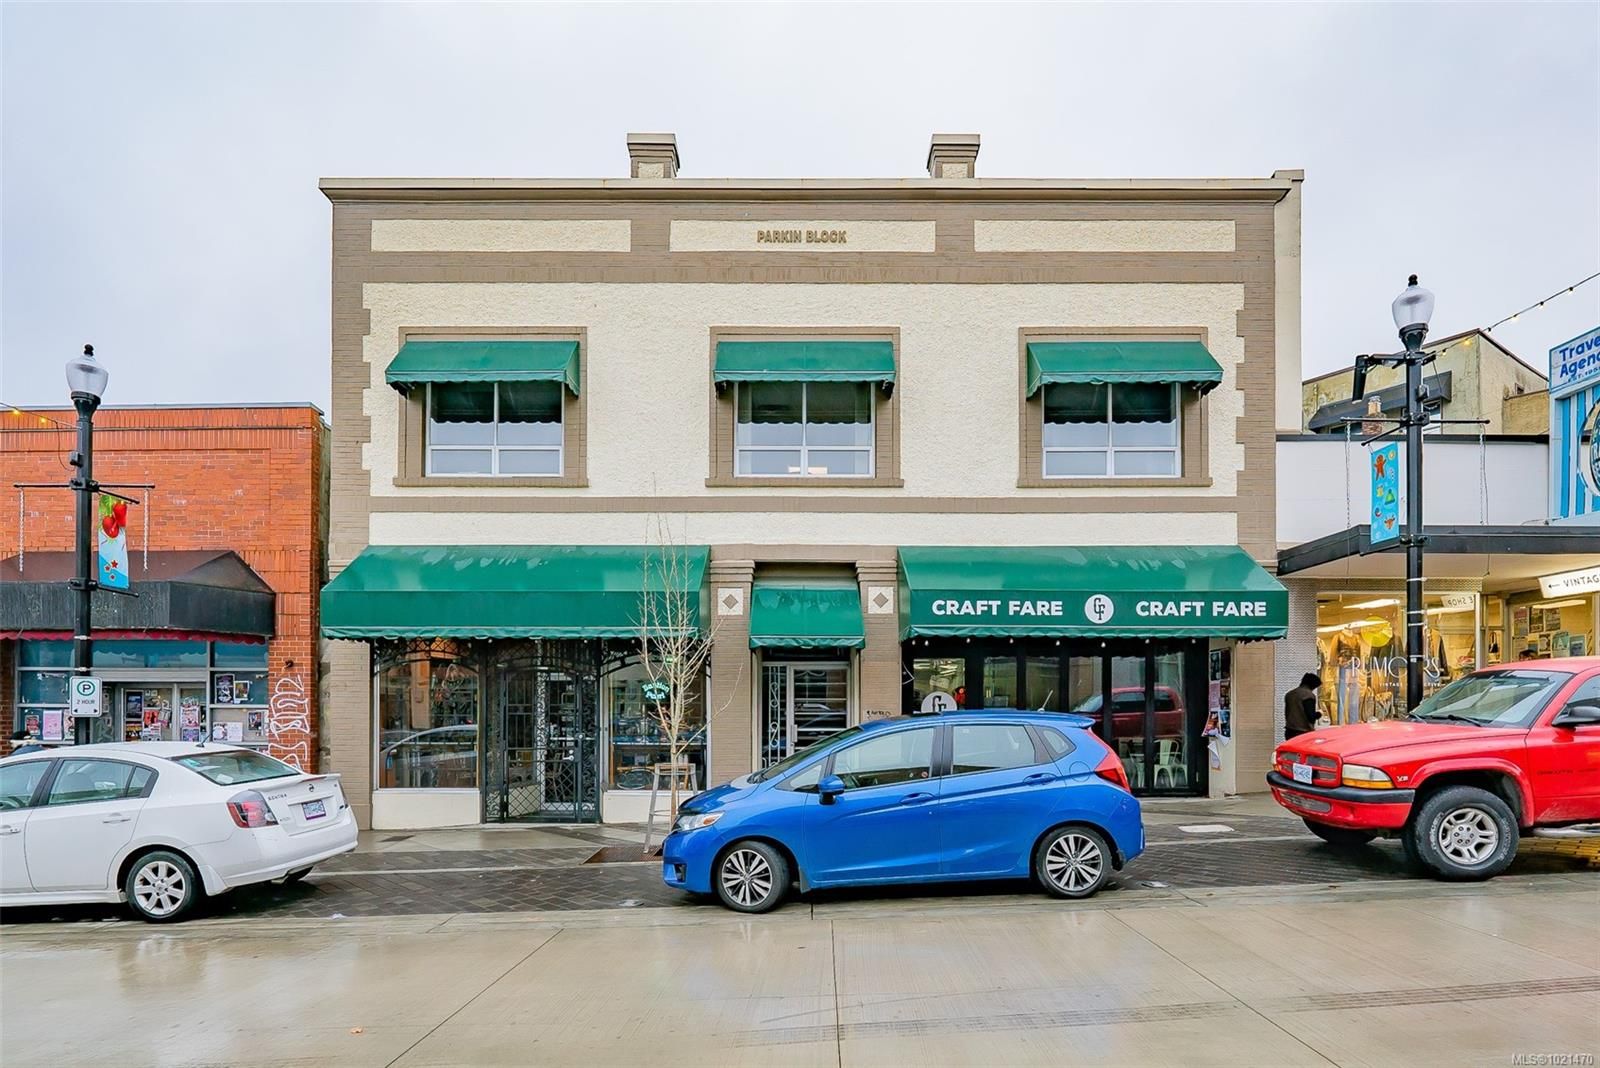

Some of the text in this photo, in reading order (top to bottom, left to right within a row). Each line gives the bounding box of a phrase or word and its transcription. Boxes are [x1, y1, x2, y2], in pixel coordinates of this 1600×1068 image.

[757, 230, 847, 243] PARKIN BLOCK
[1563, 574, 1600, 587] VINTAG
[932, 600, 1063, 615] CRAFT FARE
[1135, 601, 1267, 616] CRAFT FARE
[1351, 656, 1440, 678] RUMORS
